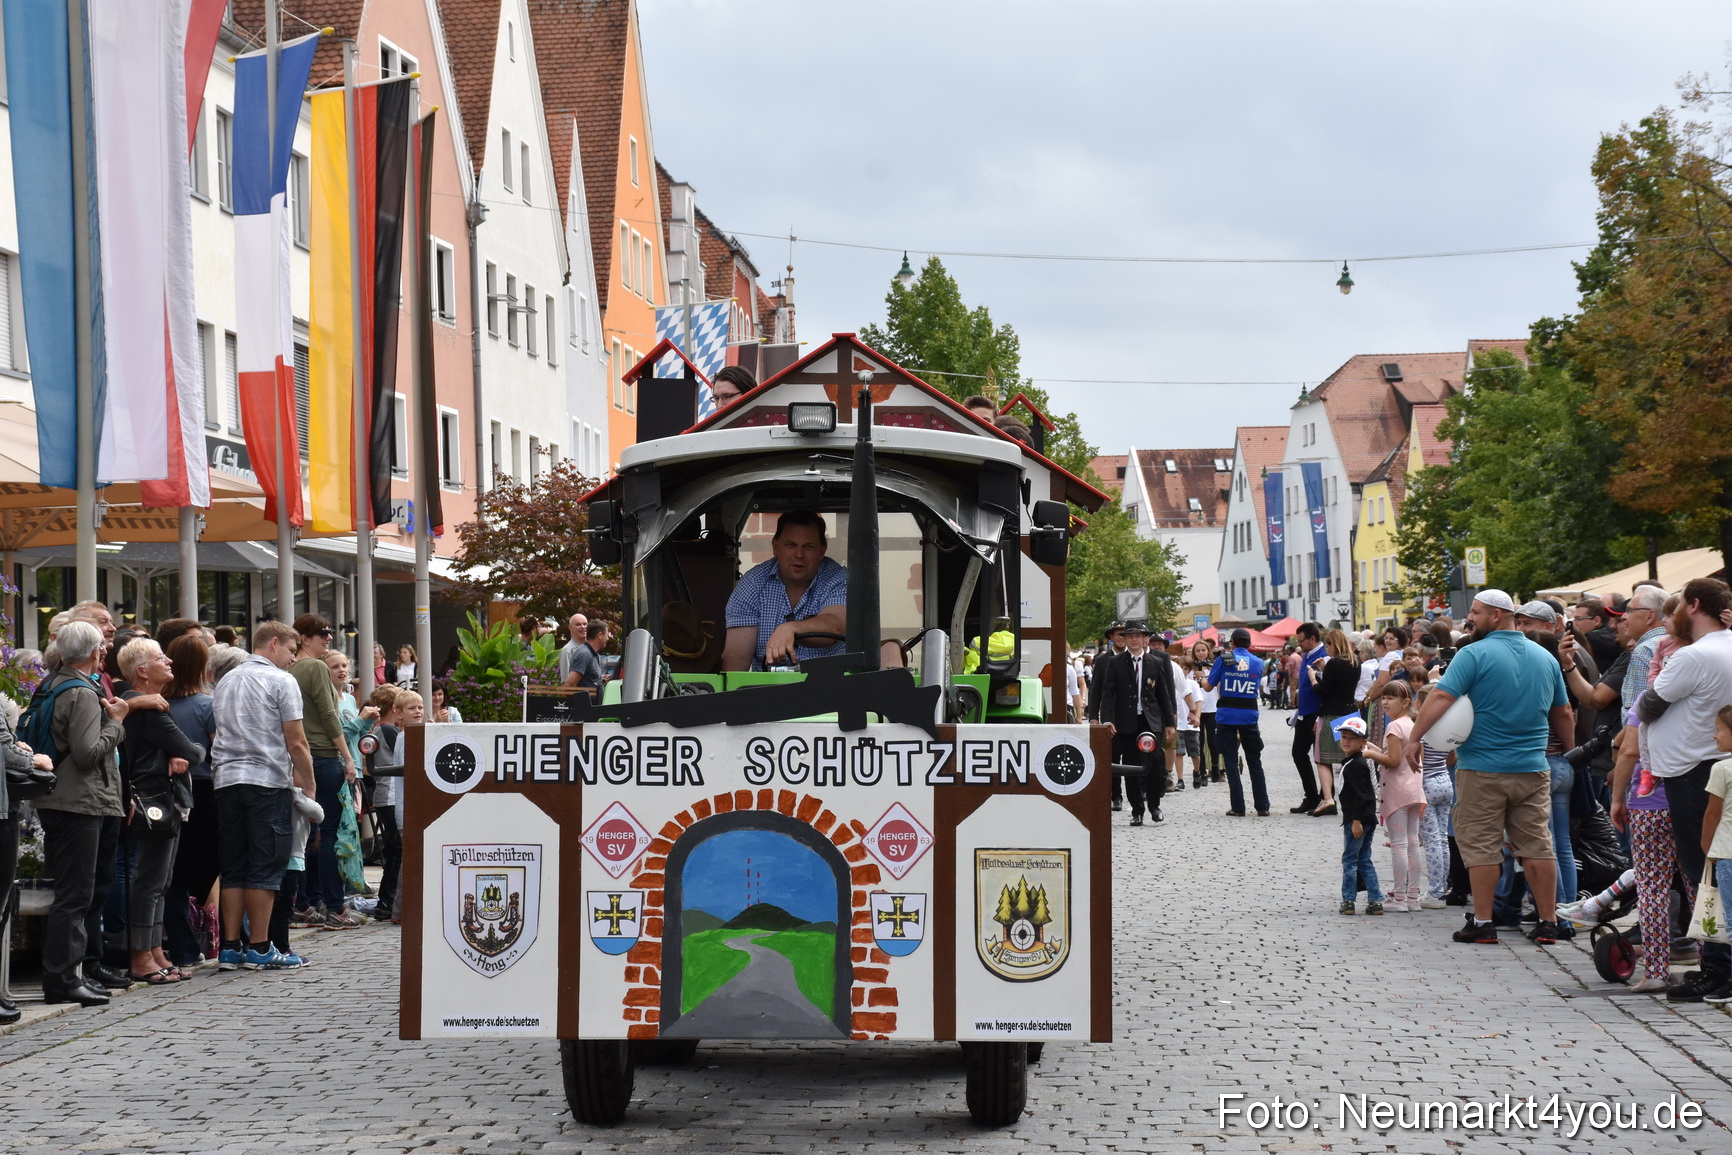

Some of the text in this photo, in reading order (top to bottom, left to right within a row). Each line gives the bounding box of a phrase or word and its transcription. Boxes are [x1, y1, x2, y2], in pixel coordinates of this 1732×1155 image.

[1224, 671, 1249, 679] neumarkt
[1224, 678, 1256, 694] LIVE
[494, 734, 1030, 786] HENGER SCHÜTZEN
[585, 836, 649, 845] 19 63
[598, 832, 634, 840] HENGER
[866, 836, 930, 845] 19 63
[879, 832, 916, 841] HENGER
[607, 843, 626, 856] SV
[889, 844, 907, 856] SV
[610, 864, 622, 872] eV
[893, 865, 904, 873] eV
[476, 954, 507, 972] Heng
[442, 1015, 540, 1030] www.henger-sv.de/schuetzen
